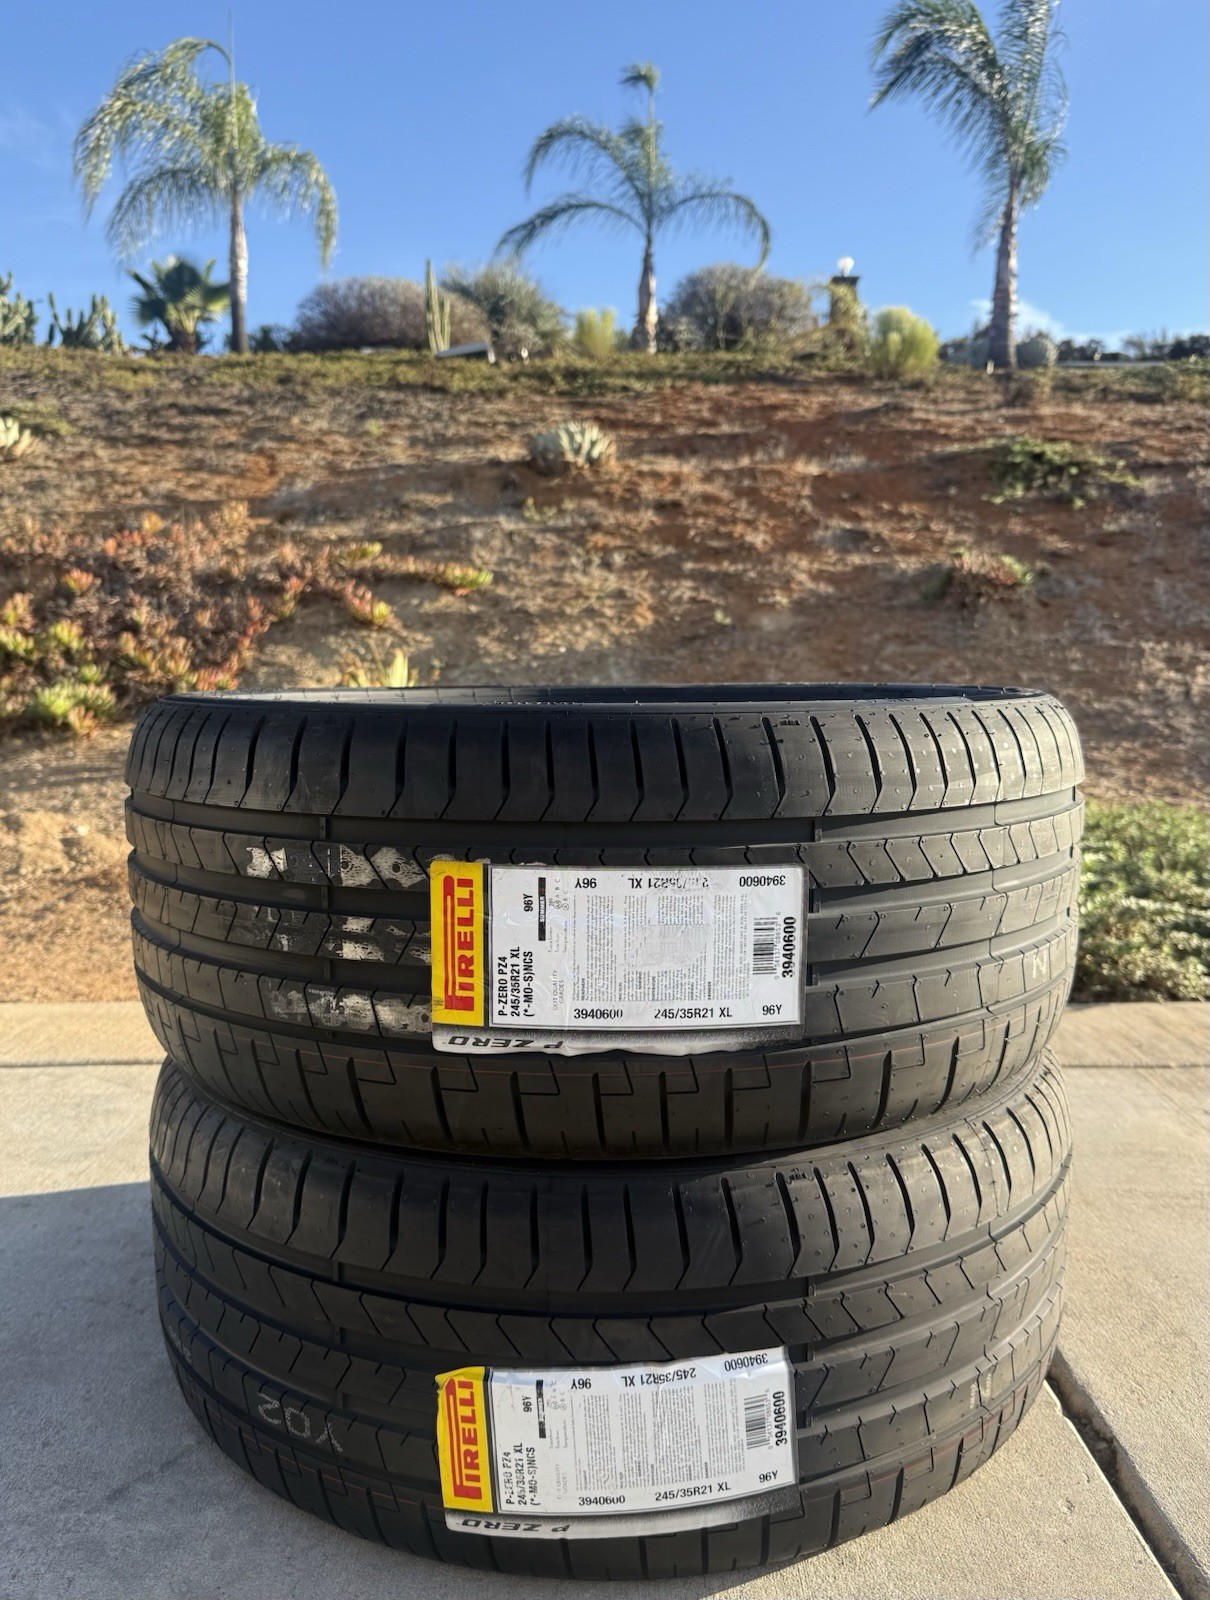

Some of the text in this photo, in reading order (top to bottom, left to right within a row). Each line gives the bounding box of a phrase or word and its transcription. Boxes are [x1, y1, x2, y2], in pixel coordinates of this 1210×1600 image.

[574, 877, 597, 889] 96Y
[628, 877, 642, 889] XL
[739, 875, 787, 887] 3940600
[523, 893, 534, 912] 96Y
[443, 875, 475, 1012] PIRELLI
[782, 916, 797, 979] 3940600
[498, 956, 508, 1017] P-ZERO PZ4
[510, 946, 521, 1017] 245/35R21 XL
[573, 1007, 623, 1020] 3940600
[653, 1007, 733, 1019] 245/35R21 XL
[762, 1004, 782, 1016] 96Y
[448, 1036, 565, 1049] P ZERO
[724, 1352, 769, 1372] 3940600
[571, 1377, 592, 1390] 96Y
[621, 1367, 697, 1388] 245/35R21 XL
[522, 1395, 533, 1413] 96Y
[772, 1390, 788, 1447] 3940600
[445, 1378, 482, 1500] PIRELLI
[513, 1443, 523, 1454] XL
[758, 1470, 778, 1483] 96Y
[654, 1481, 732, 1502] 245/35R21 XL
[578, 1495, 626, 1506] 3940600
[461, 1518, 543, 1532] ZERO
